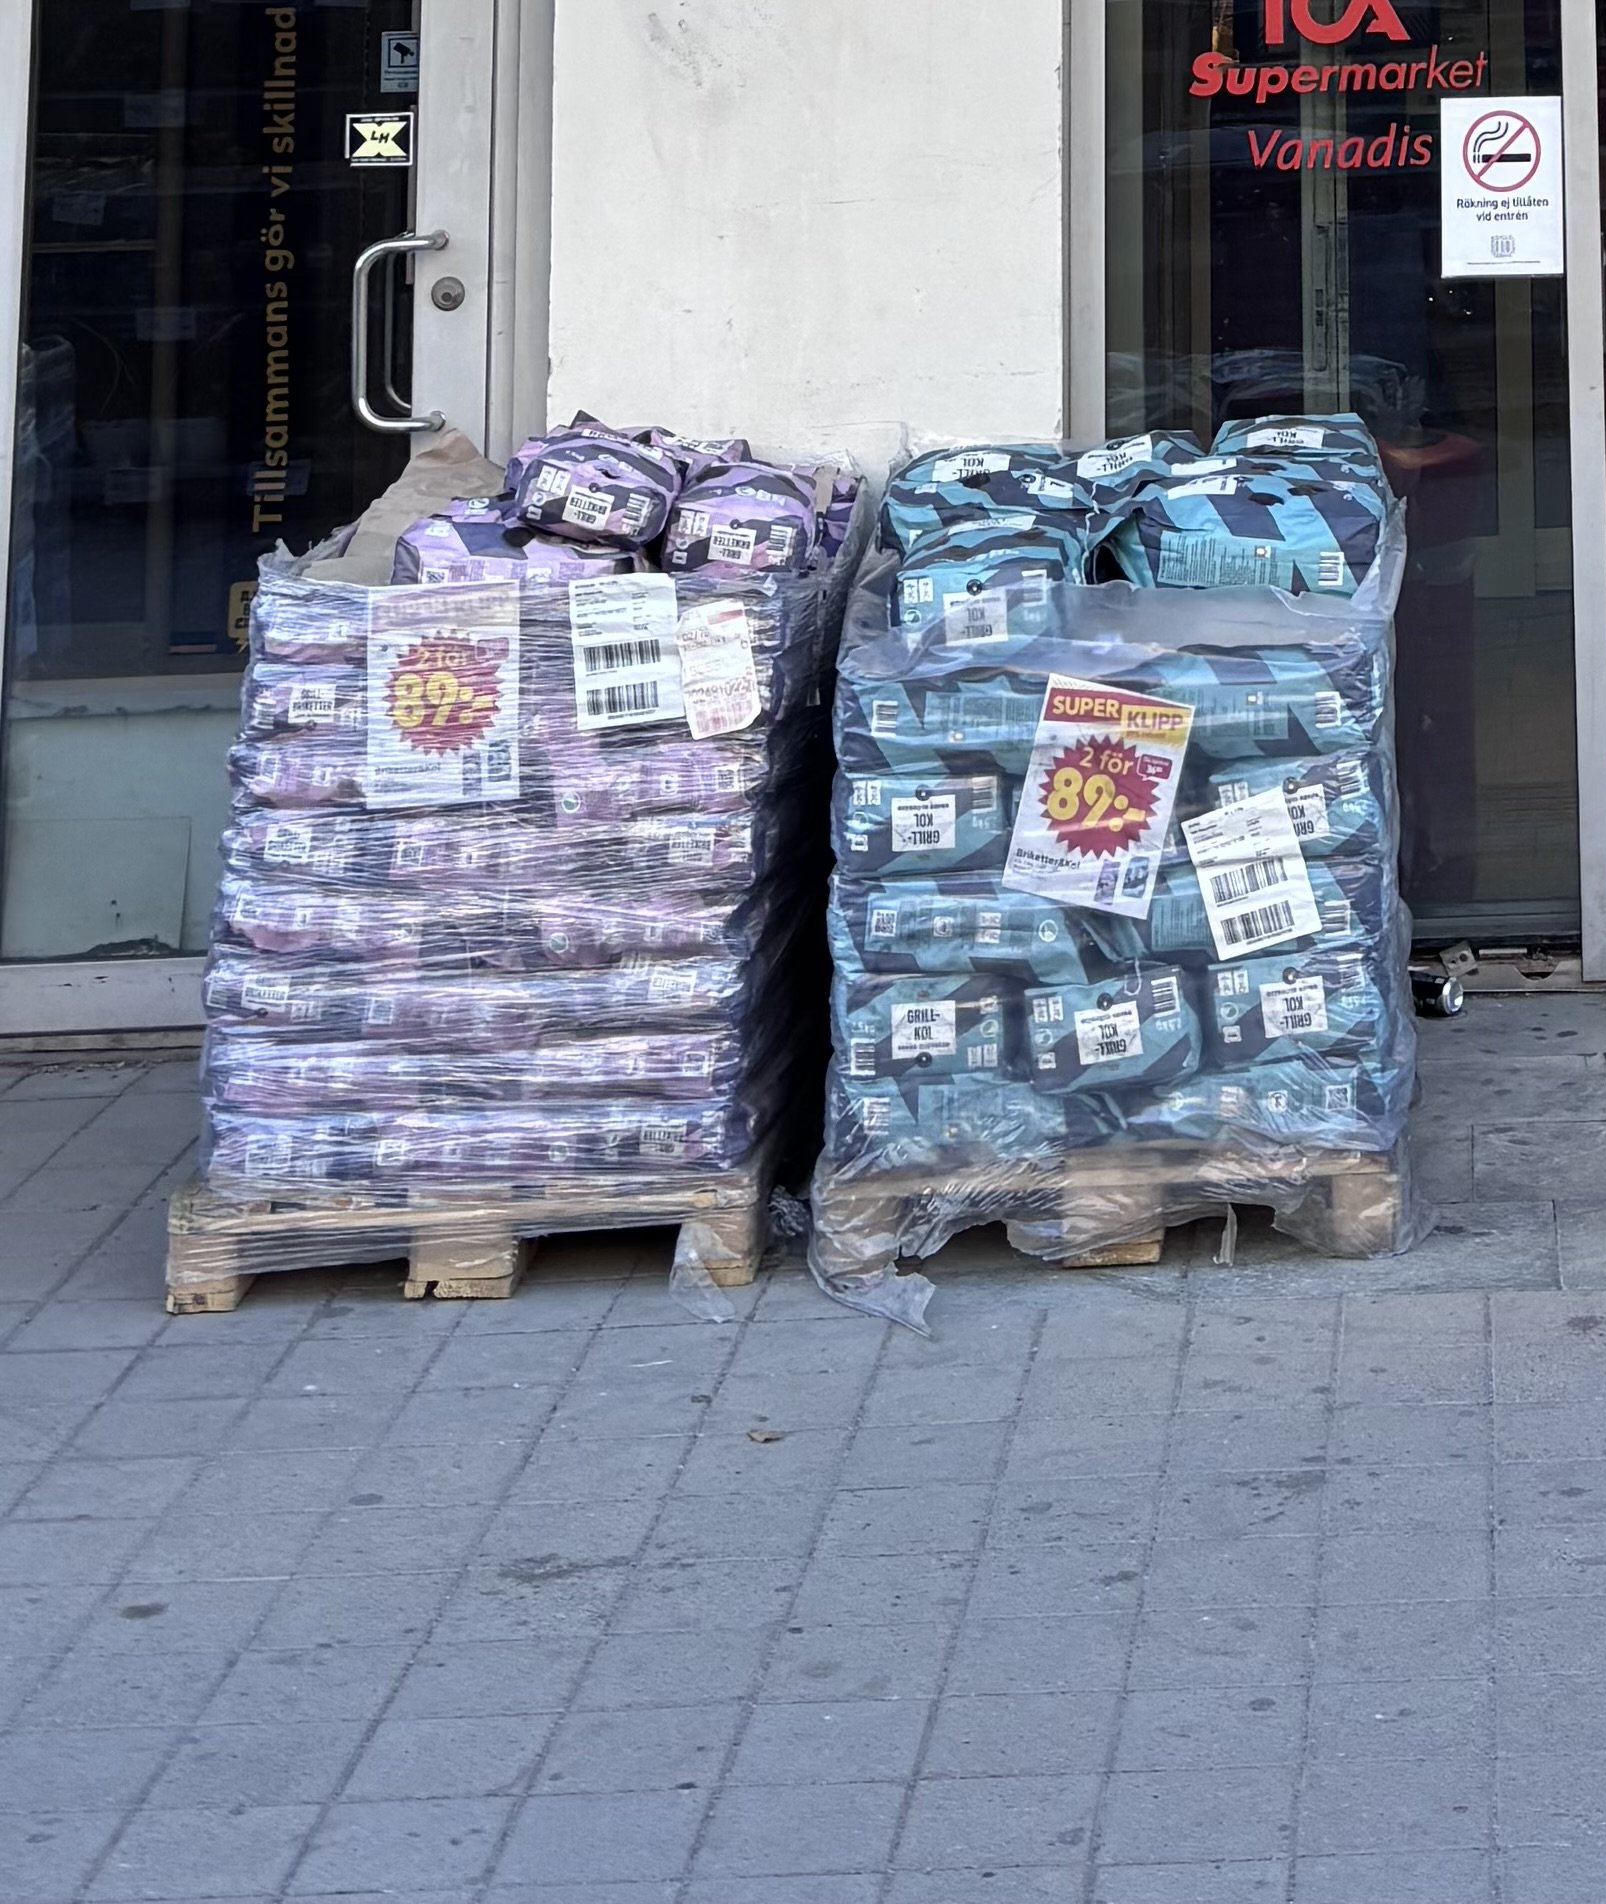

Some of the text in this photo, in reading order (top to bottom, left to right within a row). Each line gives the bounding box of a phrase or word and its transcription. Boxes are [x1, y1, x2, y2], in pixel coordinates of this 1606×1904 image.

[1188, 44, 1488, 104] Supermarket
[370, 130, 390, 144] LH
[1247, 122, 1433, 171] Vanadis
[1456, 195, 1549, 210] Rökning ej tillåten
[1476, 210, 1529, 222] vid entrén
[252, 6, 297, 533] Tillsammans gör vi skillnad
[960, 457, 985, 468] KOL
[1052, 695, 1120, 719] SUPER
[1126, 710, 1184, 731] KLIPP
[1079, 746, 1095, 768] 2
[1099, 749, 1134, 775] för
[913, 813, 934, 828] KOL
[907, 829, 941, 844] GRILL-
[1283, 996, 1304, 1012] KOL
[907, 1008, 941, 1024] GRILL-
[1279, 1011, 1313, 1028] GRILL-
[913, 1025, 934, 1041] KOL
